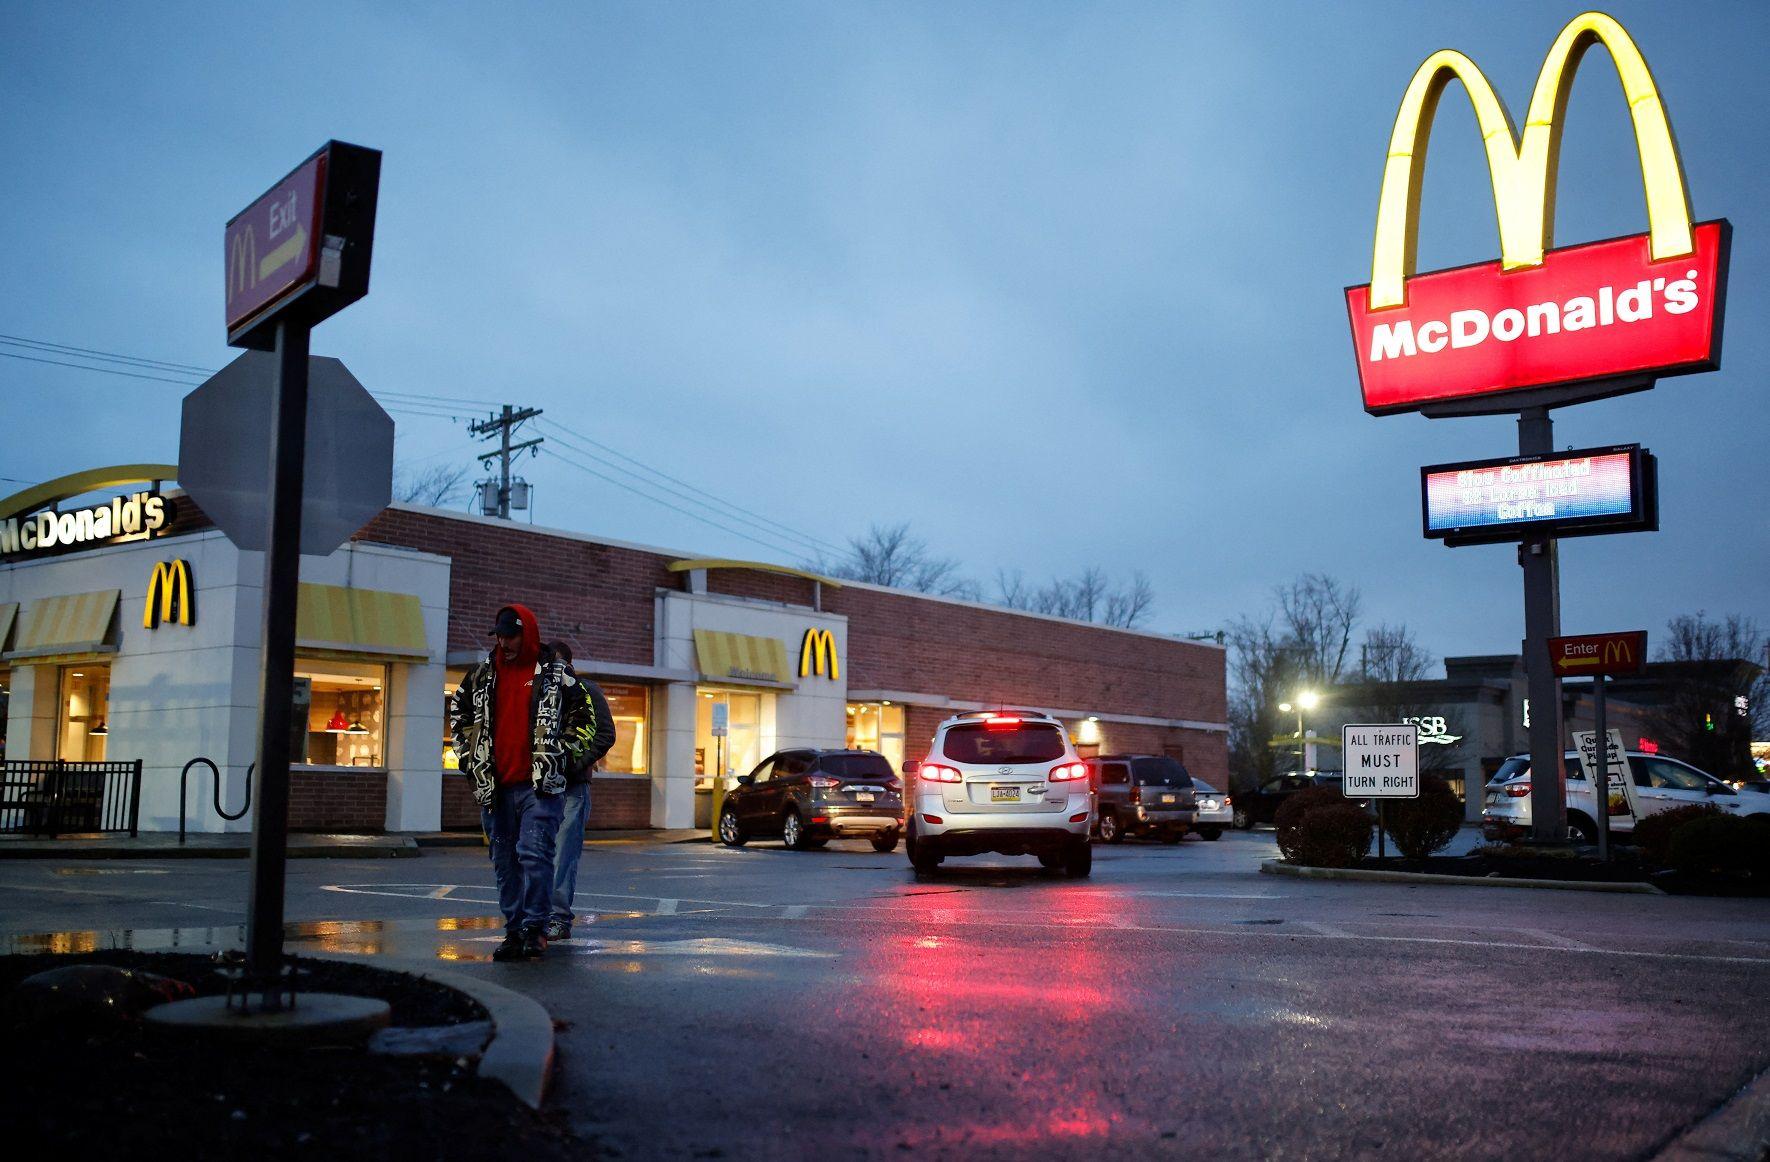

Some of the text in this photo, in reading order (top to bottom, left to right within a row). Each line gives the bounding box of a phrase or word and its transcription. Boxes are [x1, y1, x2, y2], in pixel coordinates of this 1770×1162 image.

[269, 190, 297, 240] Exit
[1369, 277, 1699, 362] McDonald's
[1498, 501, 1555, 520] Coffee
[1564, 643, 1599, 656] Enter
[1350, 734, 1411, 746] ALL TRAFFIC
[1361, 754, 1401, 768] MUST
[1348, 776, 1414, 788] TURN RIGHT
